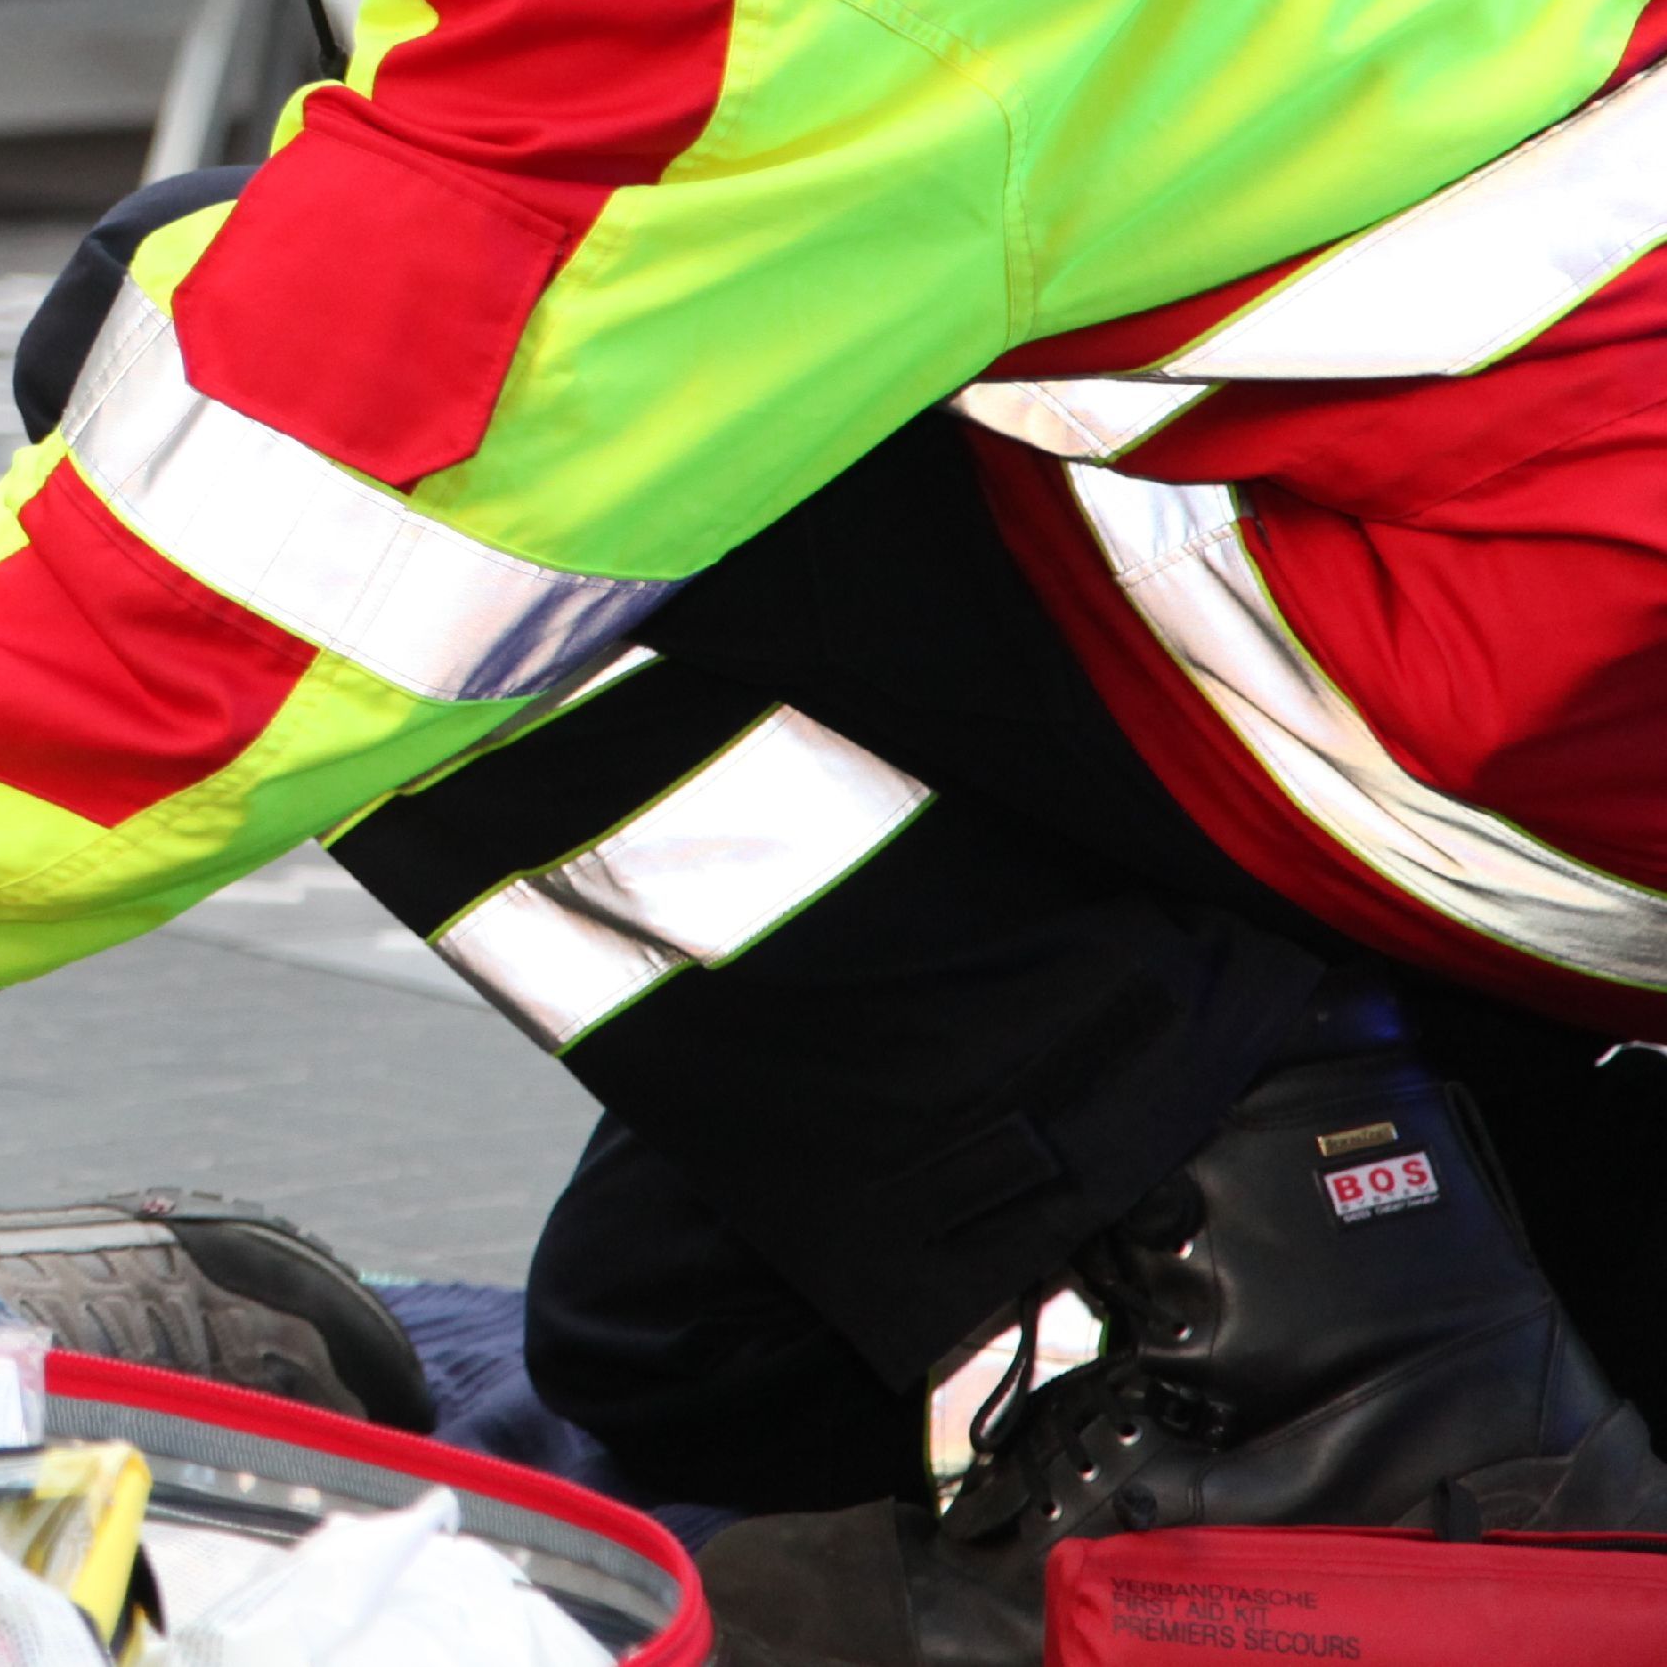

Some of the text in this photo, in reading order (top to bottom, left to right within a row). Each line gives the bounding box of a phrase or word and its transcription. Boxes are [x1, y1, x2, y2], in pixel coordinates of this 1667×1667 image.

[1333, 1159, 1428, 1203] BOS
[1111, 1577, 1318, 1610] VERBANDTASCHE
[1112, 1591, 1271, 1627] FIRST AID KIT
[1111, 1615, 1361, 1661] PREMIERS SECOURS
